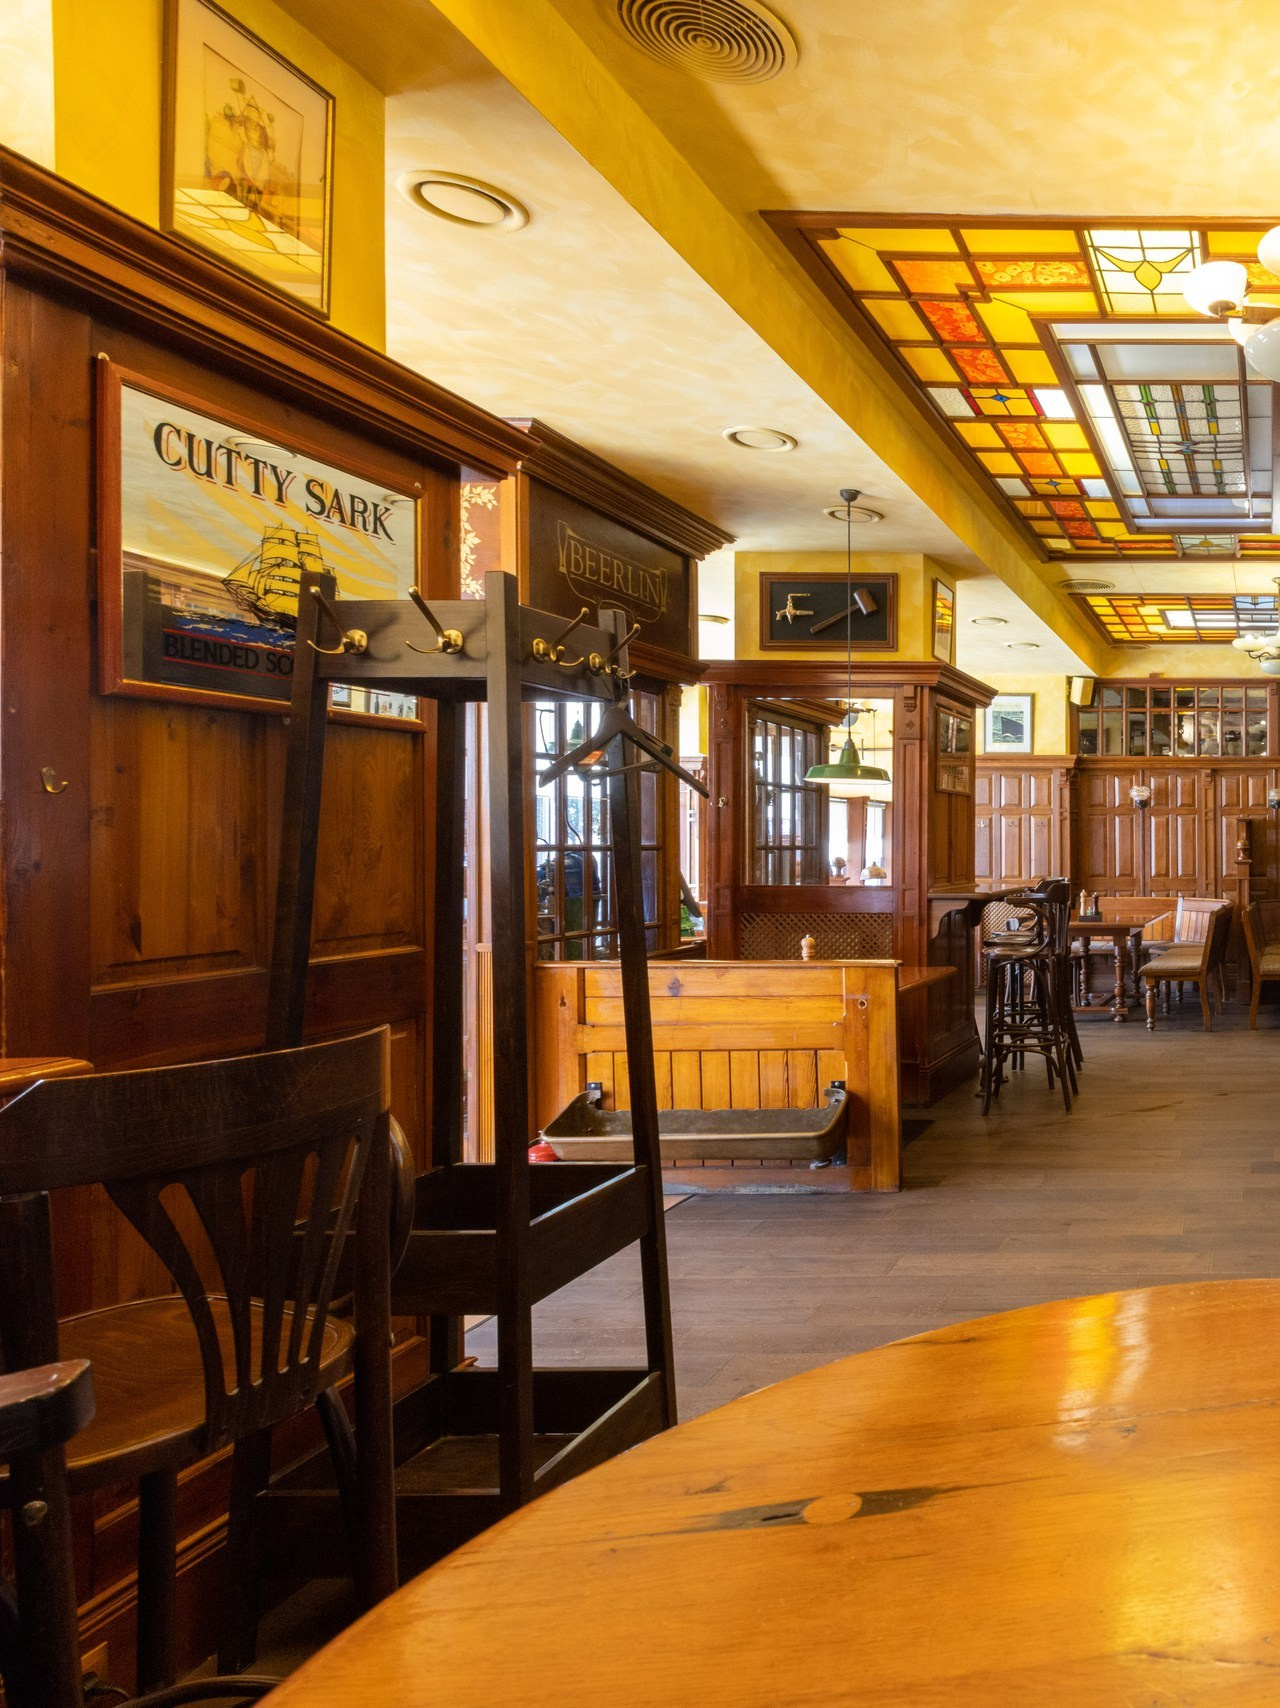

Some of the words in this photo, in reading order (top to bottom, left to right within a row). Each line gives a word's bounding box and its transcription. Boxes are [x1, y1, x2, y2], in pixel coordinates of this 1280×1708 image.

[153, 422, 296, 508] CUTTY
[305, 479, 395, 545] SARK
[570, 540, 660, 606] BEERLIN
[163, 634, 259, 670] BLENDED
